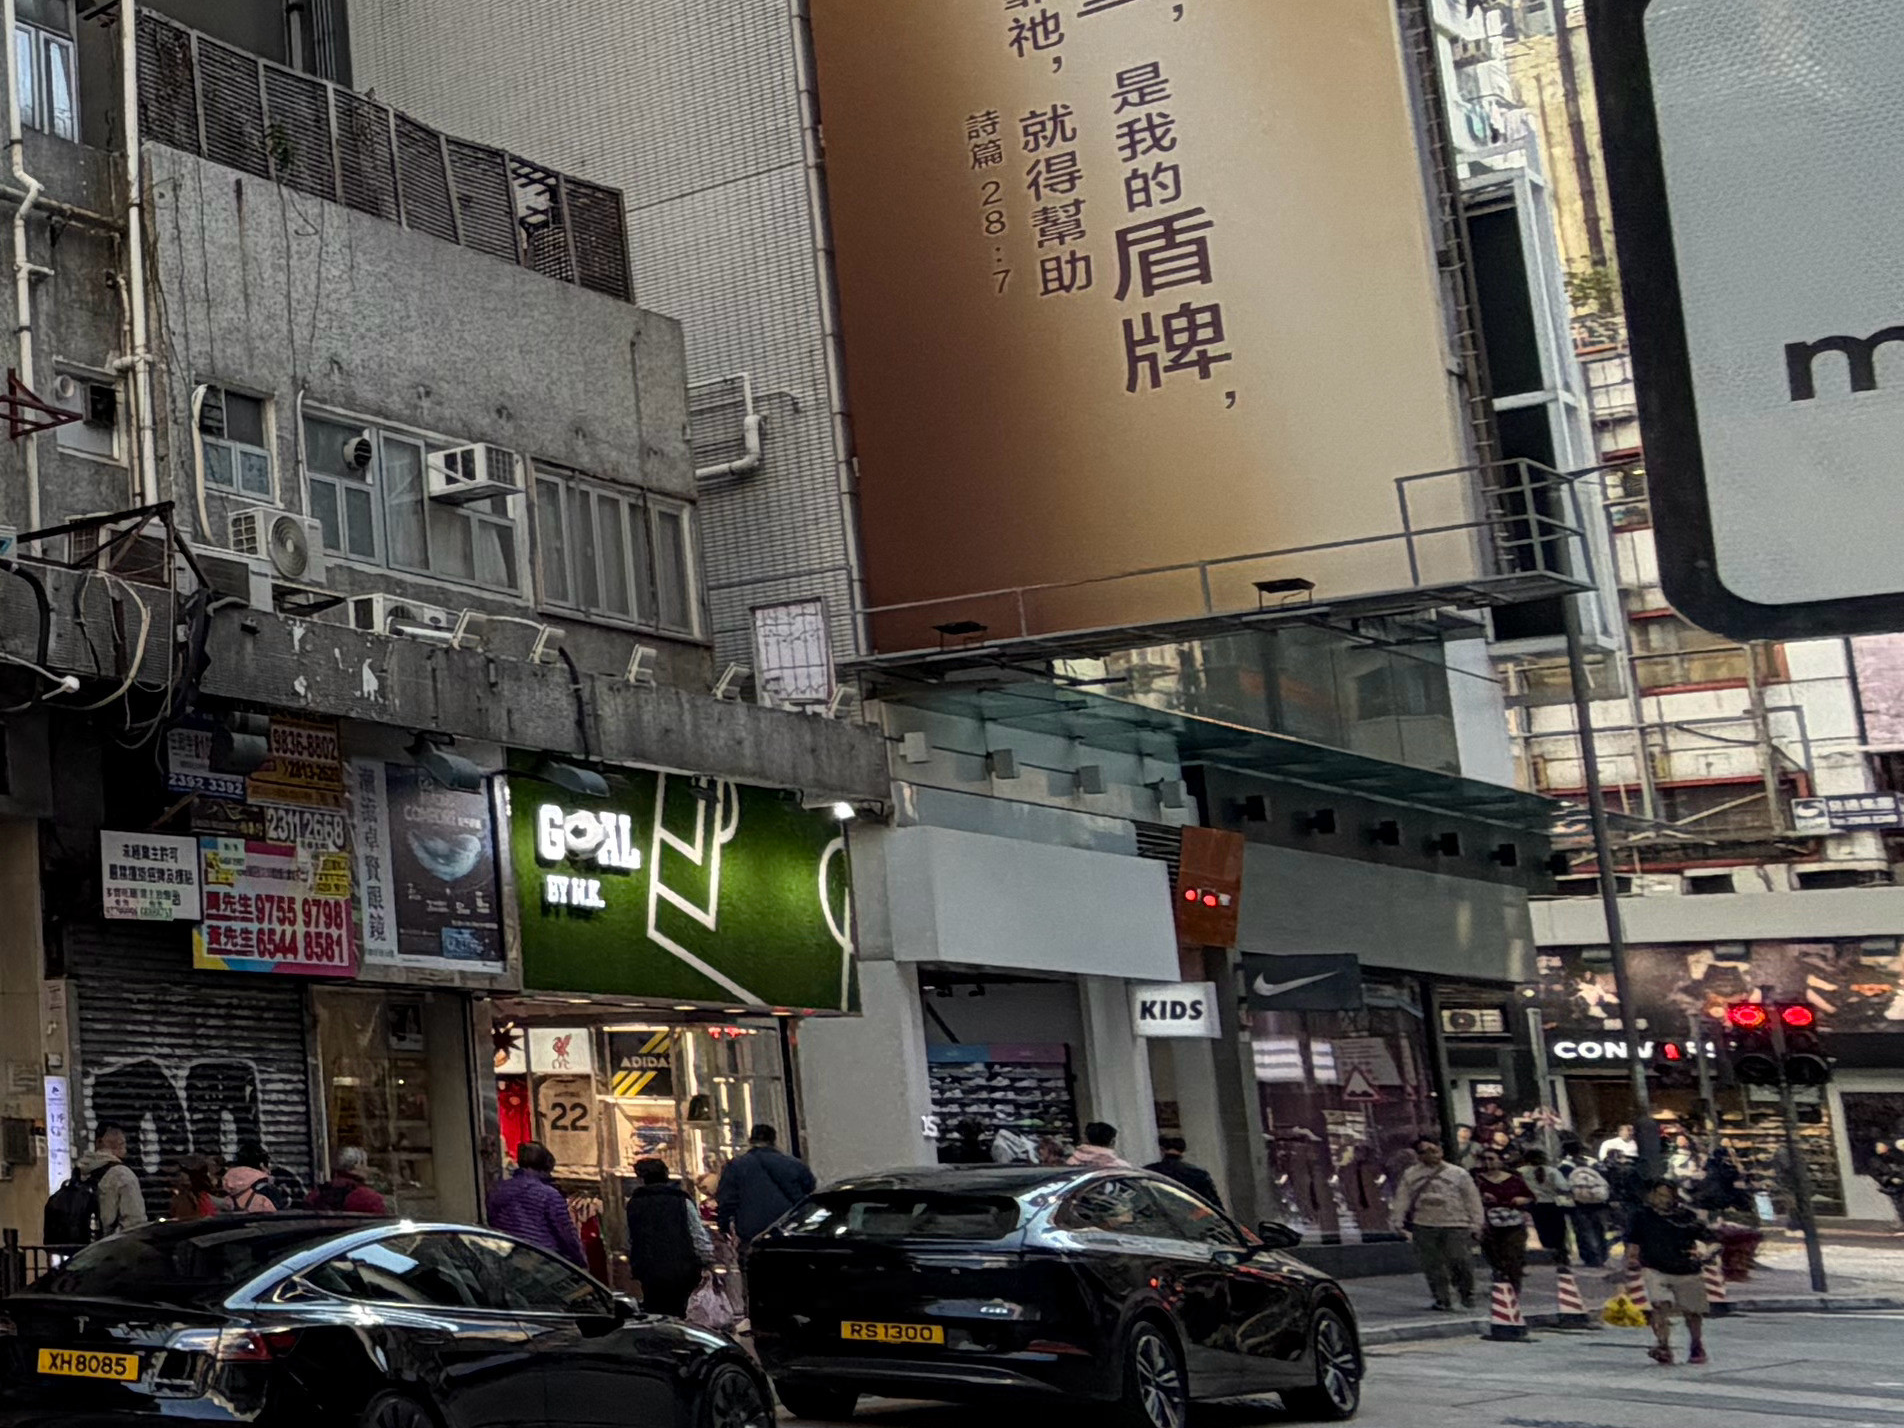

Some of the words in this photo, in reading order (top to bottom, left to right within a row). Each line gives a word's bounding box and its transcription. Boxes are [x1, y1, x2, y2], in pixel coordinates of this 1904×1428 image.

[965, 109, 1003, 170] 詩篇
[266, 808, 300, 843] 2311
[546, 874, 569, 903] BY
[255, 893, 297, 927] 9755
[302, 897, 344, 931] 9798
[256, 927, 299, 960] 6544
[304, 932, 345, 964] 8581
[1139, 999, 1204, 1021] KIDS
[550, 1102, 590, 1131] 22
